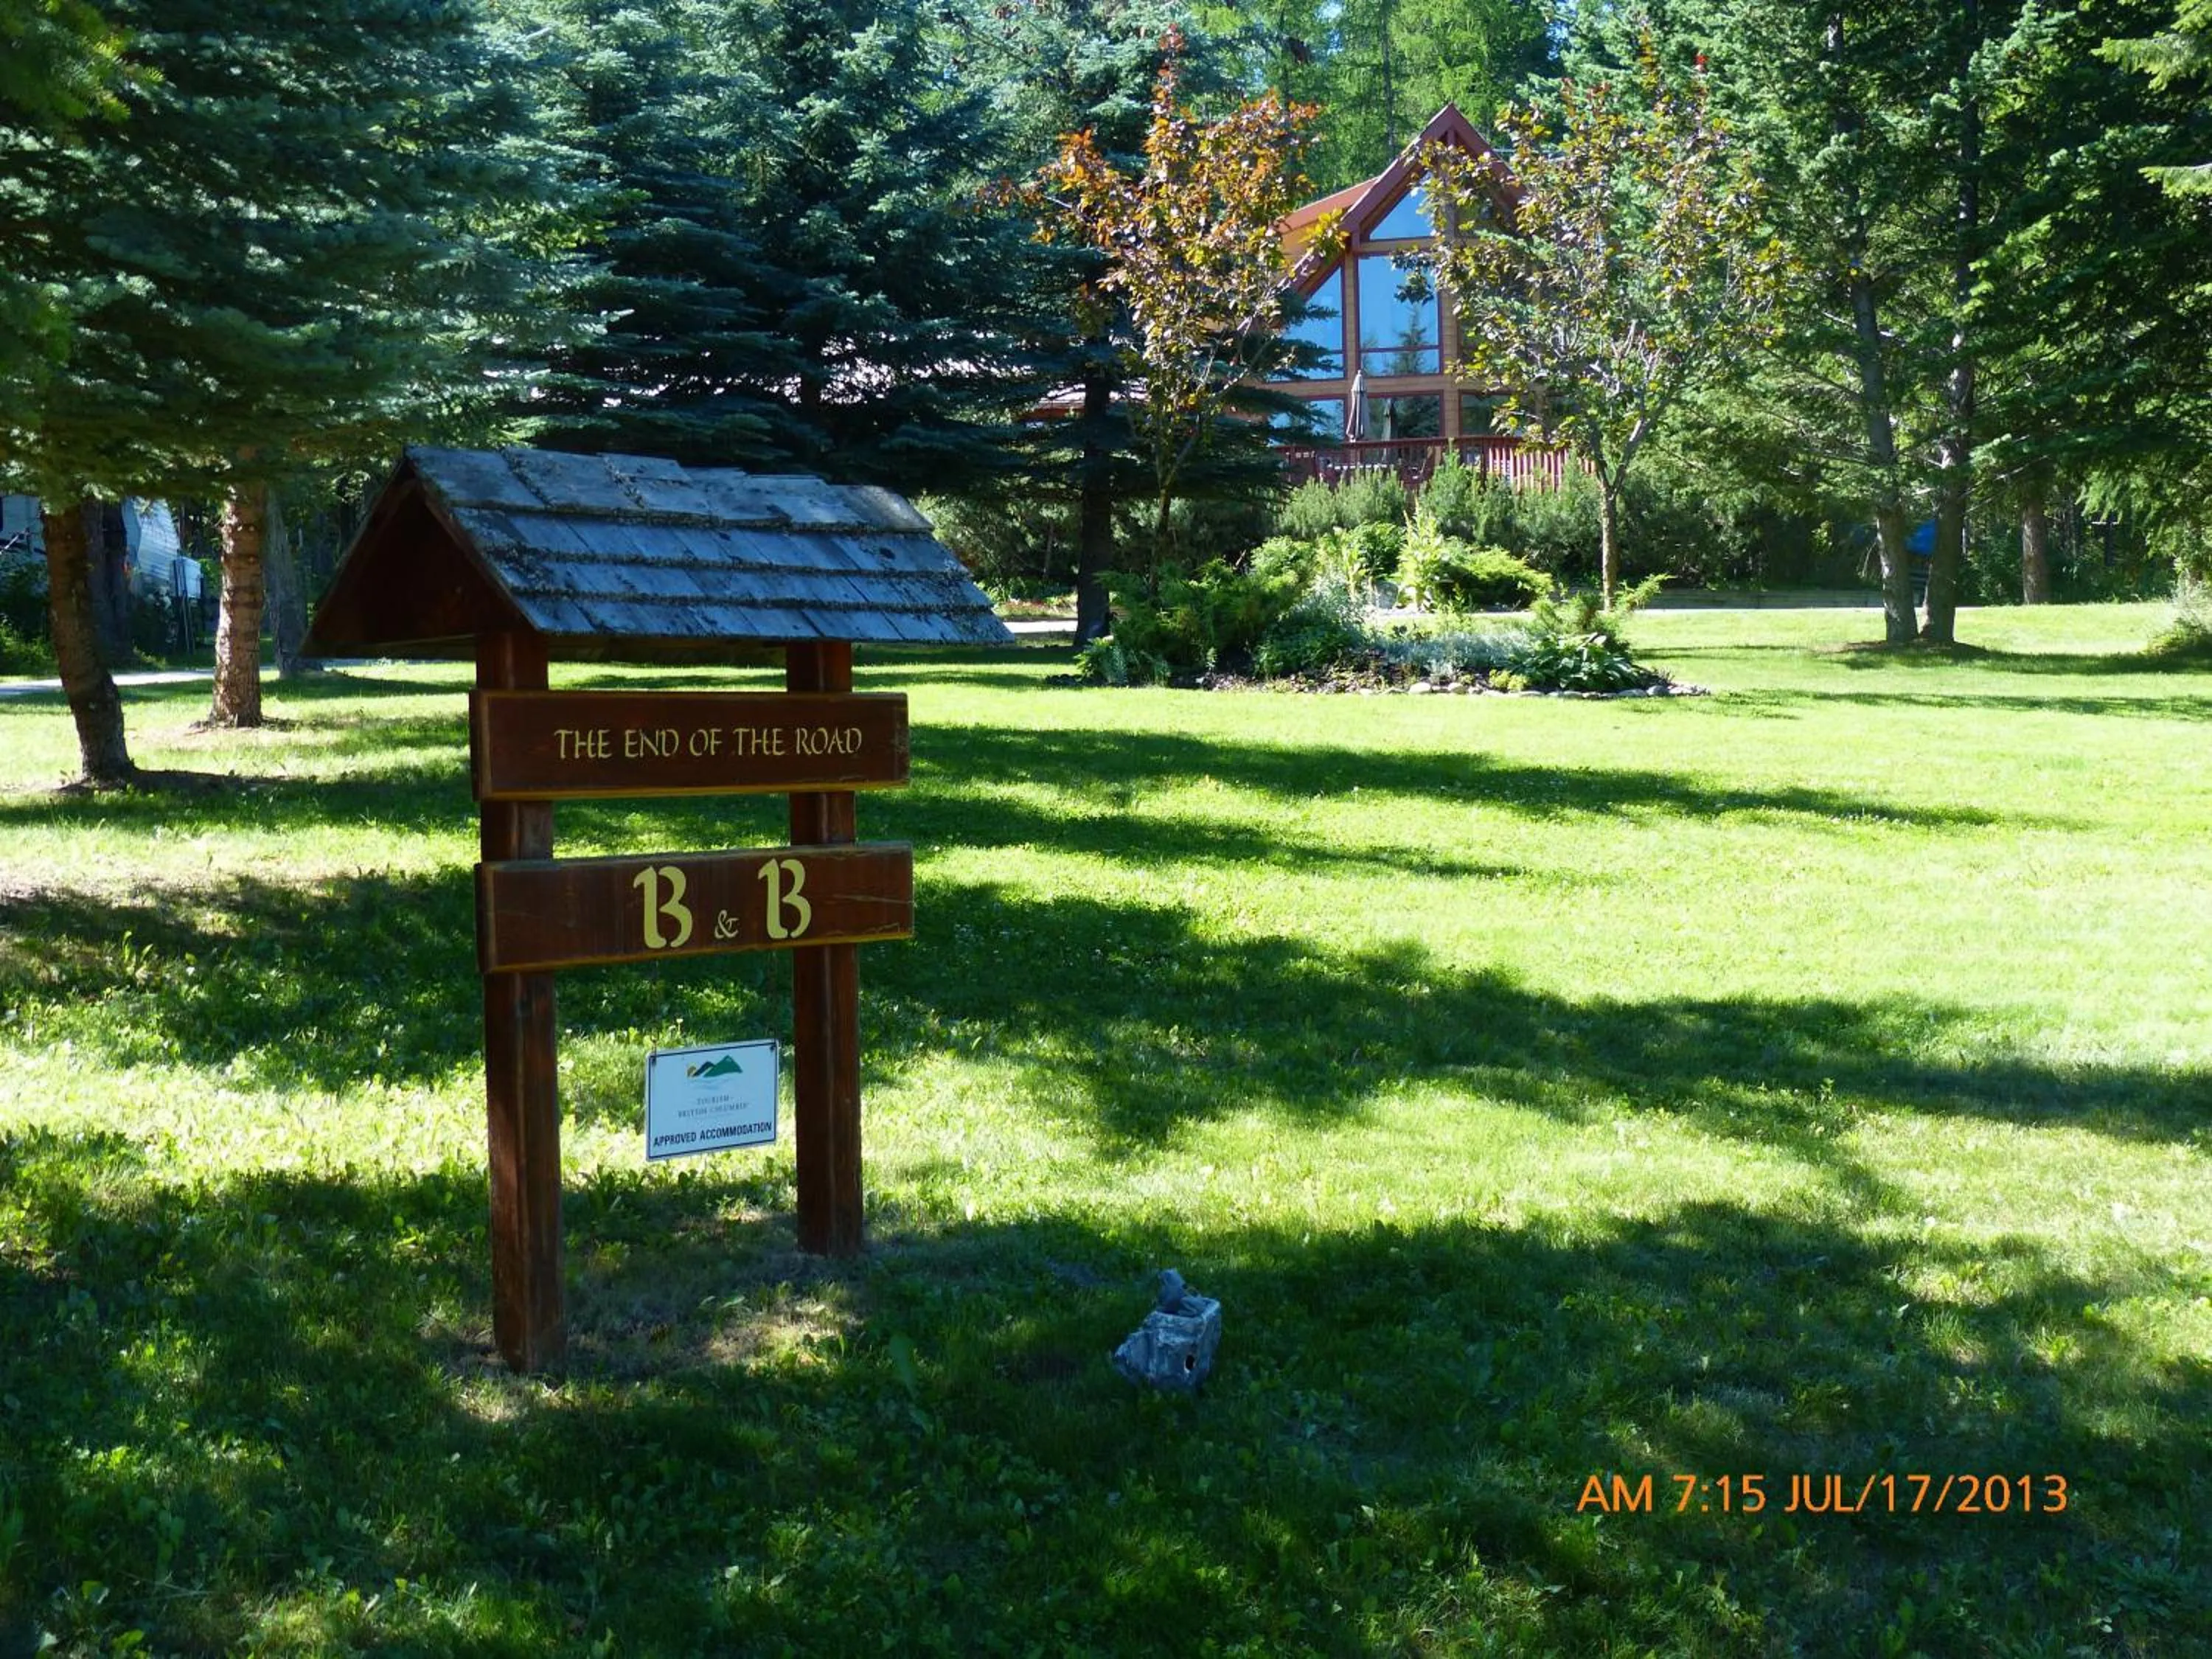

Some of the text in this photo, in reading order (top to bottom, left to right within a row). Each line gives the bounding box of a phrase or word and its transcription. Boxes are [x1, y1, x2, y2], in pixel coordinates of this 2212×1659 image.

[554, 727, 862, 759] THE END OF THE ROAD
[633, 858, 812, 949] B & B
[653, 1121, 773, 1147] APPROVED ACCOMMODATION
